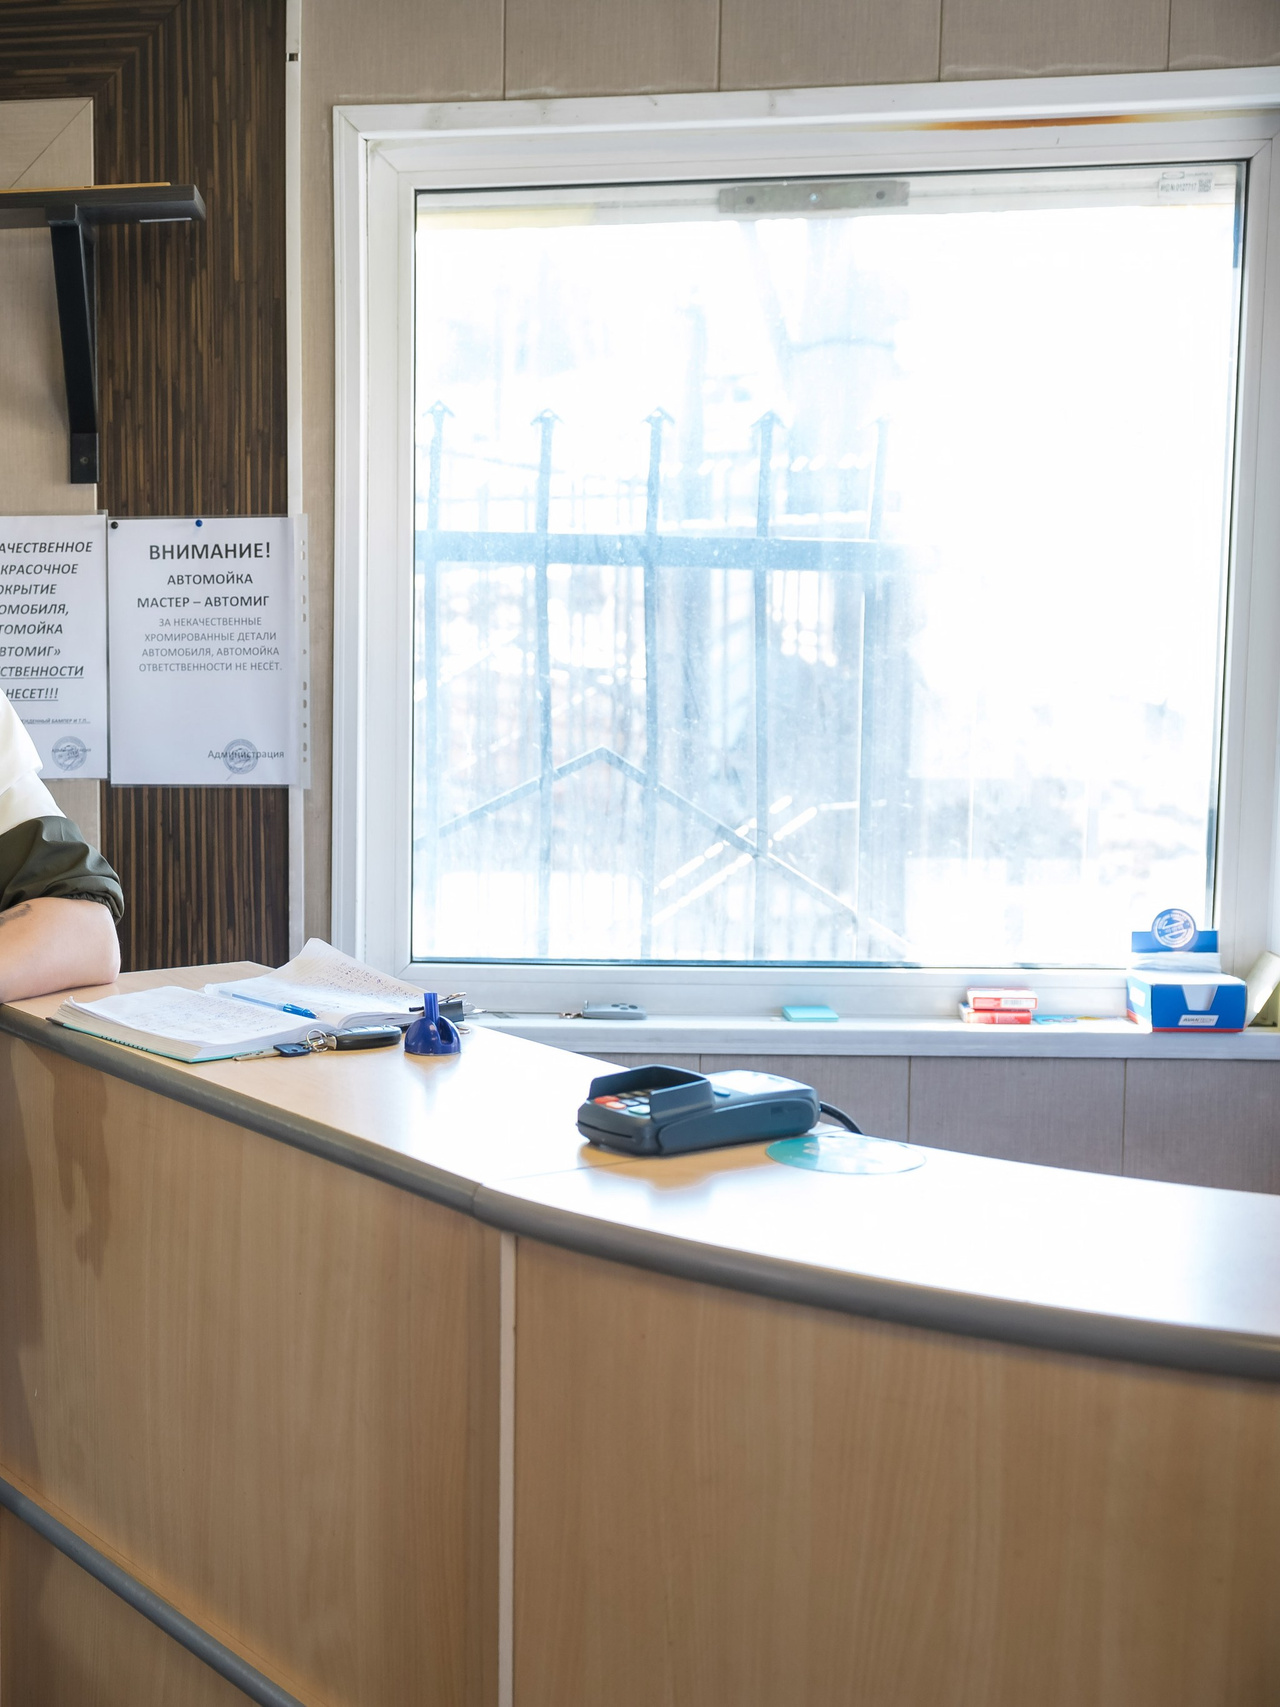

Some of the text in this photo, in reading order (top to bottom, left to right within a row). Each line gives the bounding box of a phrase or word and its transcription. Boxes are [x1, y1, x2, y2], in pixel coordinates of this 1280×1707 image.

[149, 542, 270, 560] ВНИМАНИЕ!
[167, 571, 253, 585] АВТОМОЙКА
[137, 597, 190, 608] МАСТЕР
[204, 596, 269, 607] АВТОМИГ
[159, 617, 262, 627] ЗА НЕКАЧЕСТВЕННЫЕ
[144, 632, 277, 642] ХРОМИРОВАННЫЕ ДЕТАЛИ
[142, 646, 279, 658] АВТОМОБИЛЯ, АВТОМОЙКА
[139, 662, 232, 672] ОТВЕТСТВЕННОСТИ
[235, 662, 247, 671] НЕ
[6, 688, 58, 699] НЕСЕТ!!!
[207, 750, 285, 760] Администрация
